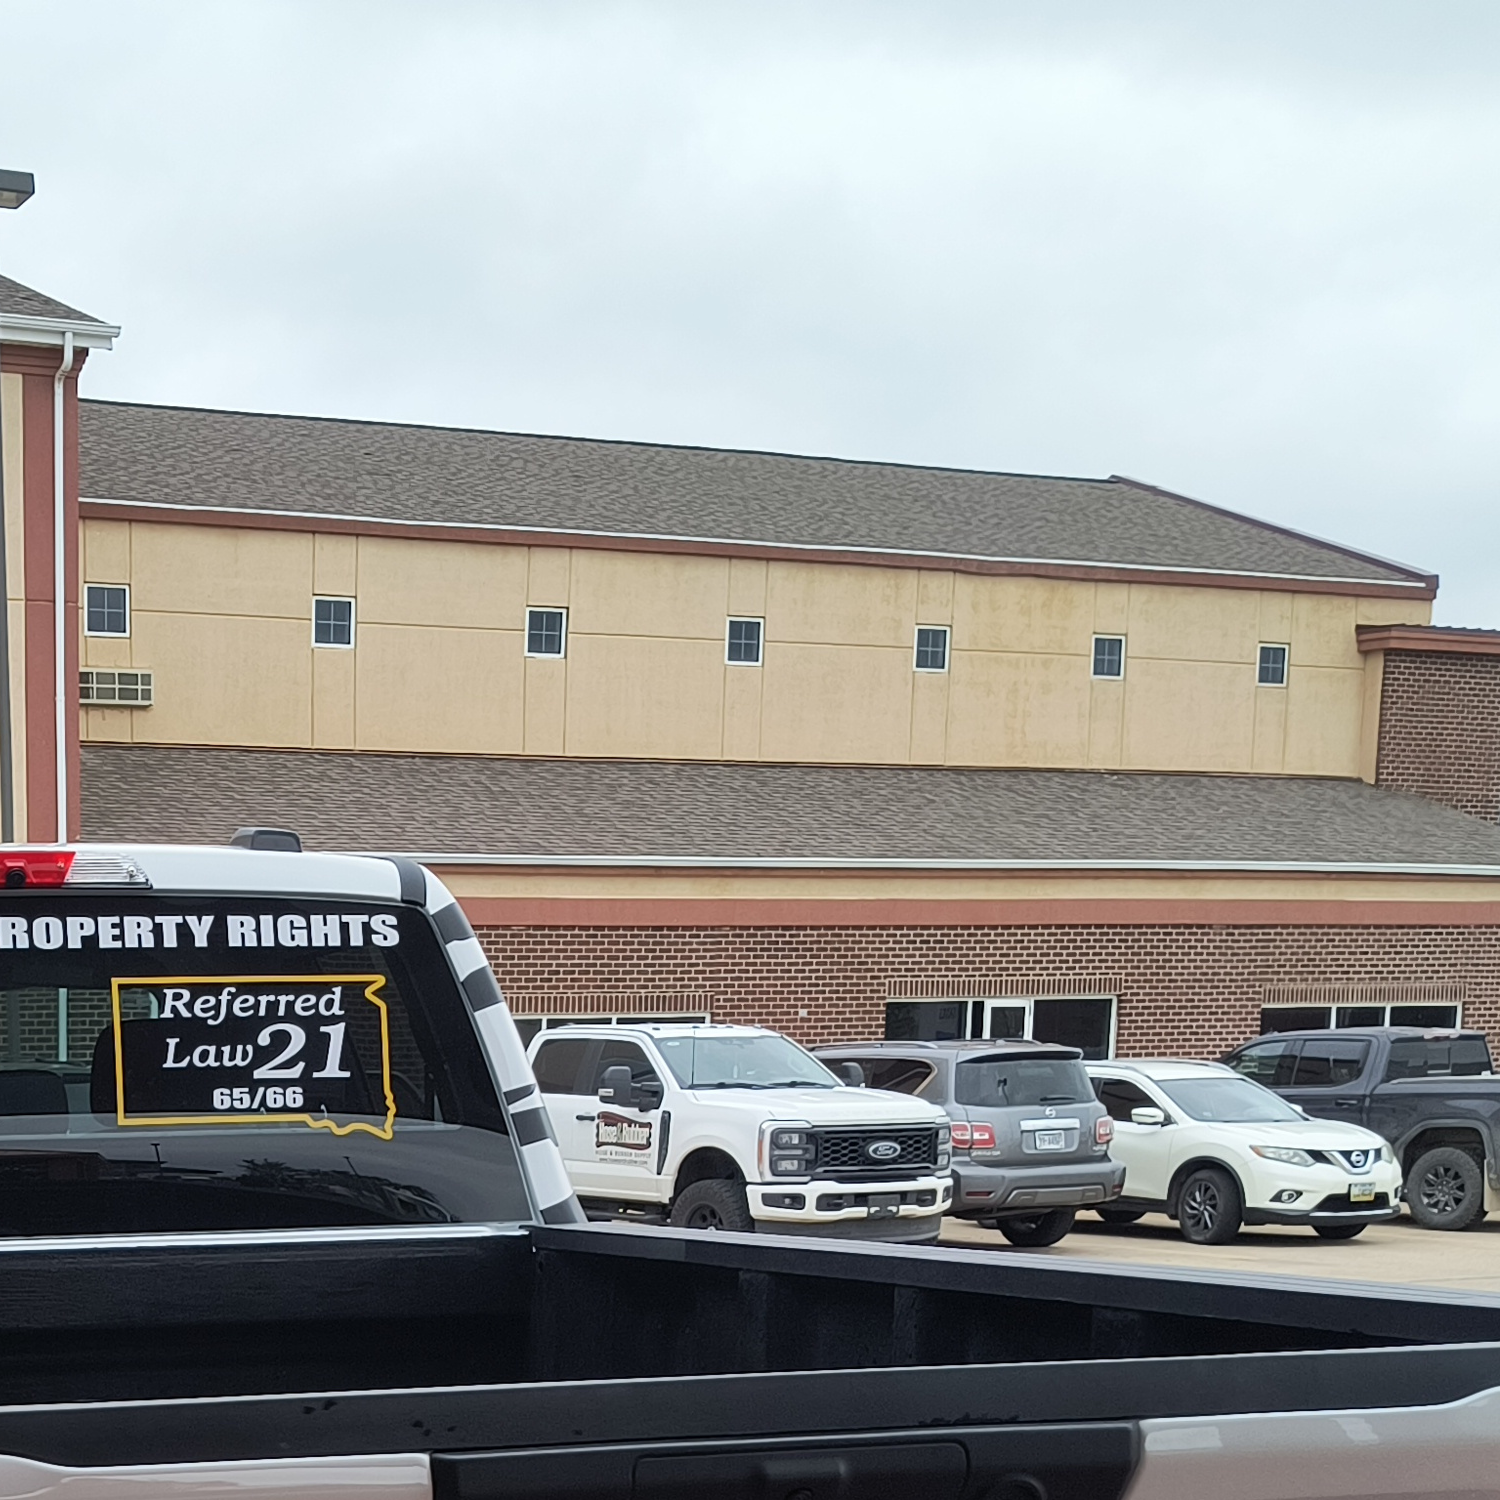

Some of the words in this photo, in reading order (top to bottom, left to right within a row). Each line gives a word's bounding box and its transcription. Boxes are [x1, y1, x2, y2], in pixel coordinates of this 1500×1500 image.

[226, 914, 400, 948] RIGHTS
[159, 986, 346, 1026] Referred
[162, 1037, 253, 1069] Law
[252, 1022, 351, 1079] 21
[212, 1086, 304, 1110] 65/66
